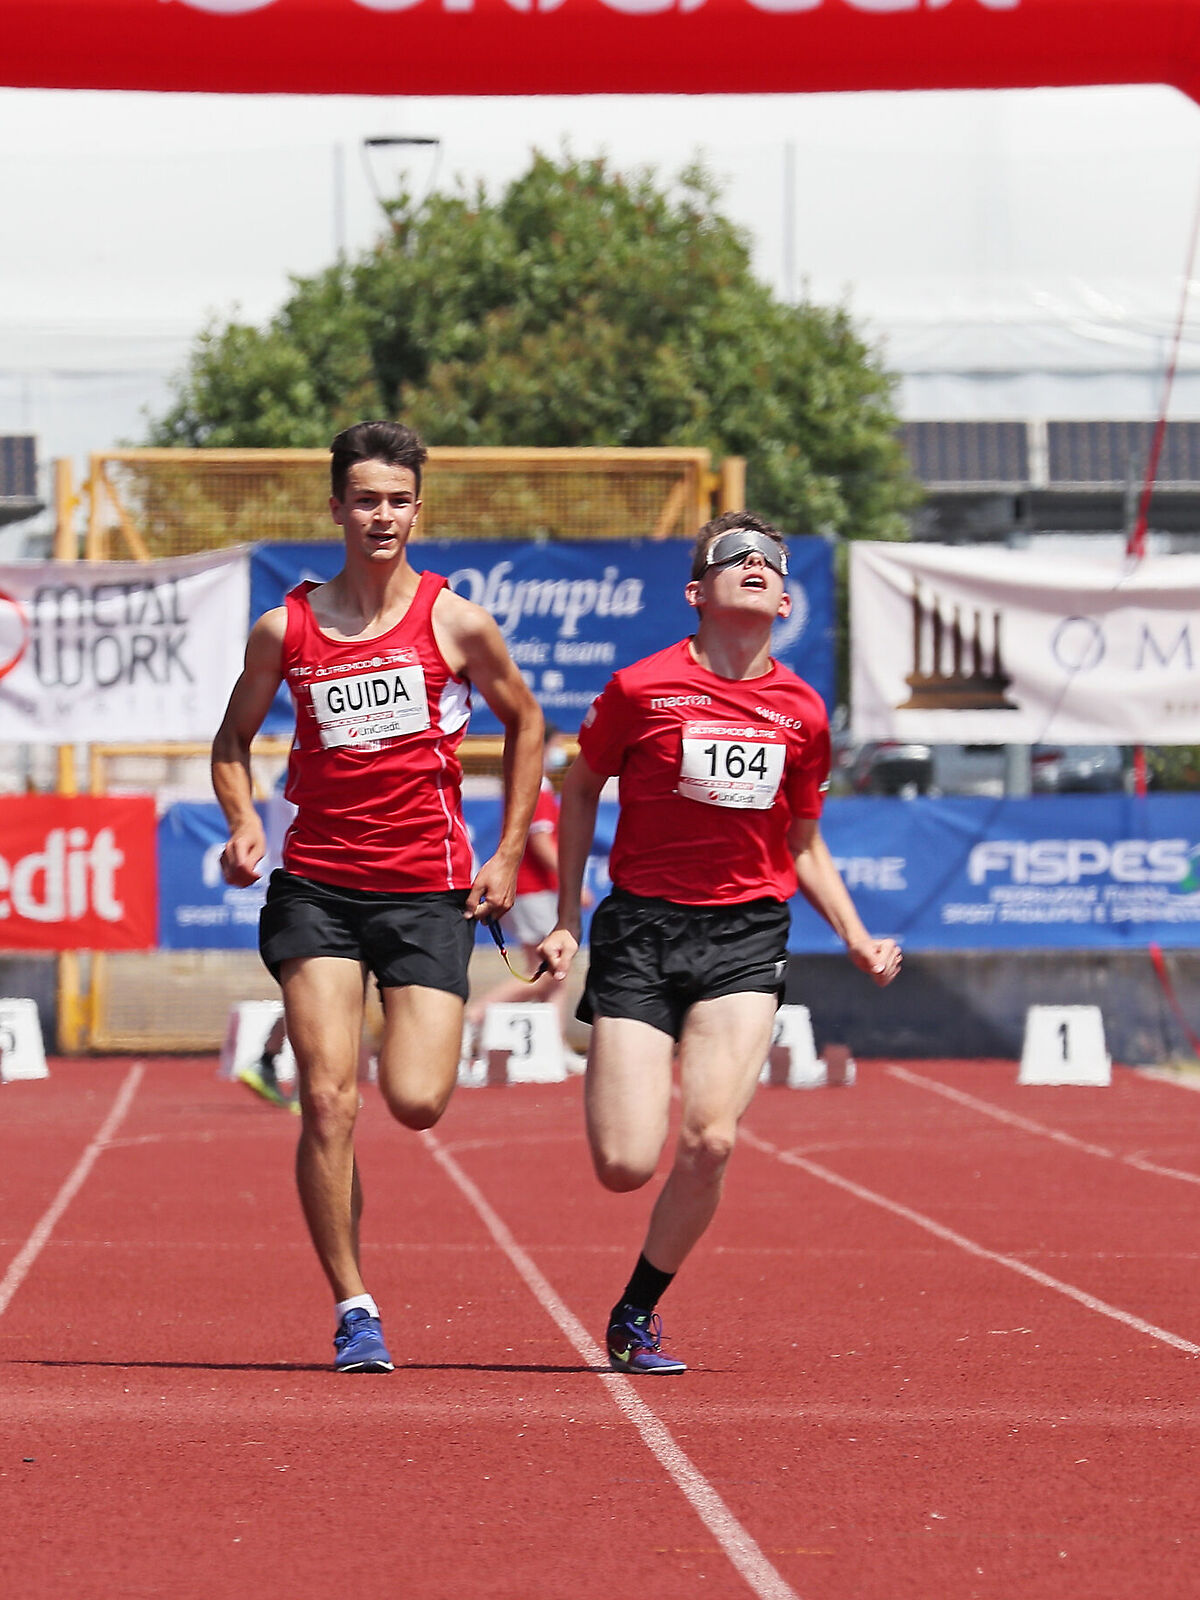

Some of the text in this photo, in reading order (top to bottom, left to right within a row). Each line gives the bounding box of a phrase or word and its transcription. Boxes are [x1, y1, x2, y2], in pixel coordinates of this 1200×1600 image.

[448, 560, 645, 638] Olympia
[35, 634, 193, 688] WORK
[327, 676, 411, 714] GUIDA
[651, 695, 712, 709] macron
[704, 743, 768, 780] 164
[968, 838, 1191, 885] FISPES
[509, 1016, 532, 1055] 3
[1056, 1021, 1071, 1062] 1
